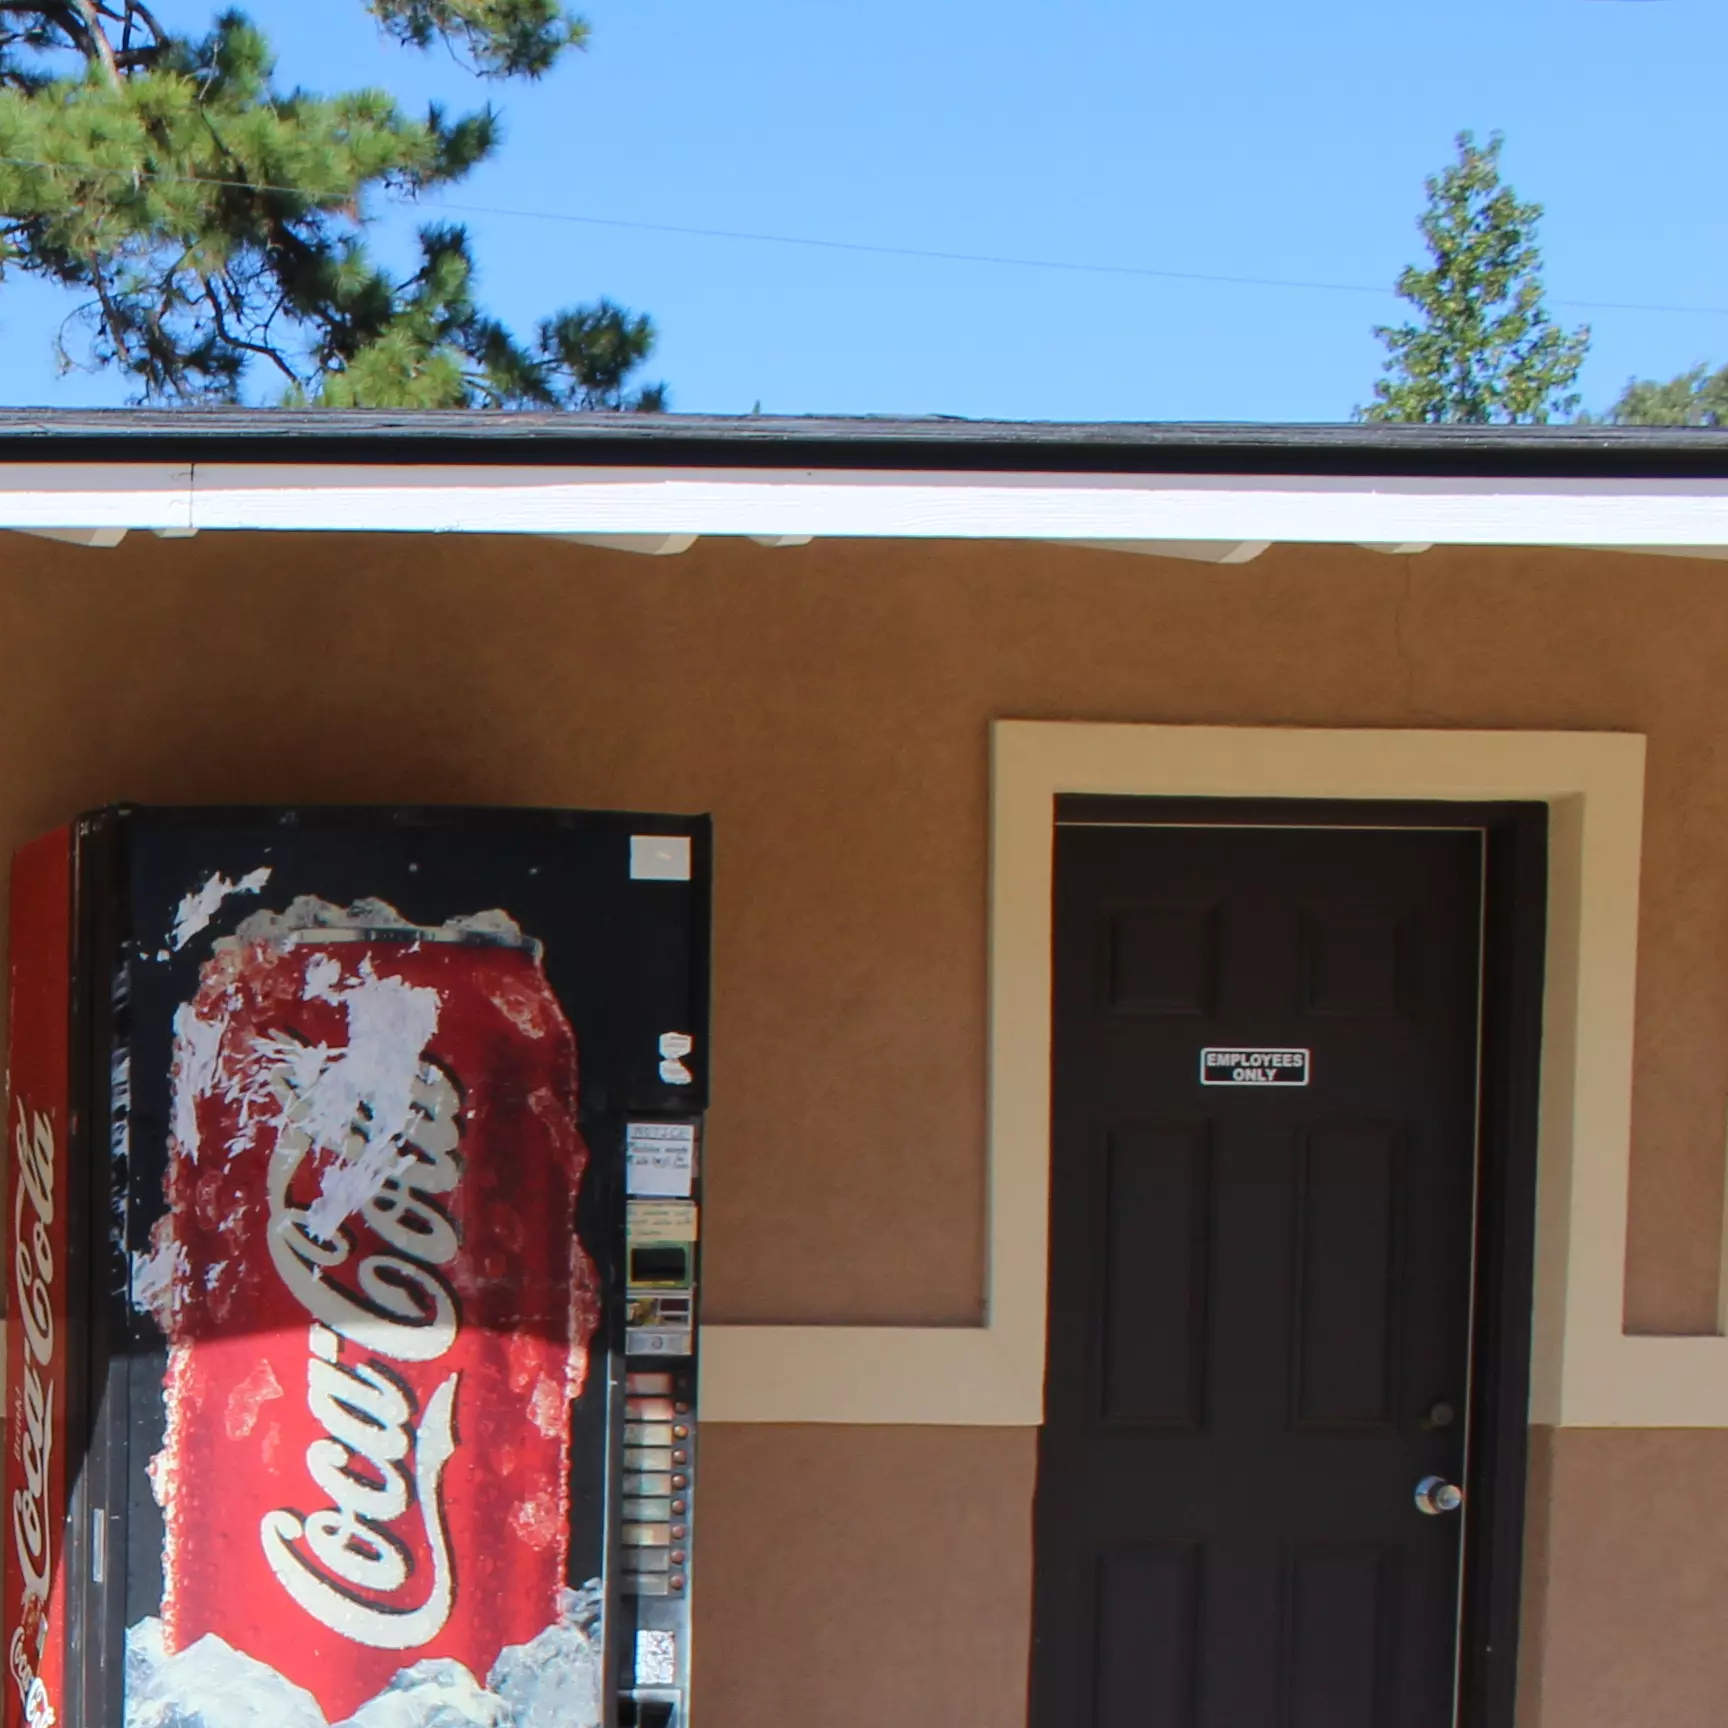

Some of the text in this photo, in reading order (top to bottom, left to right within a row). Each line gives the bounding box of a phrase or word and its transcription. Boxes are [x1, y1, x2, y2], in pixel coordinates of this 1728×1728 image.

[1206, 1053, 1304, 1081] EMPLOYEES ONLY
[13, 1095, 54, 1602] Coca-Cola
